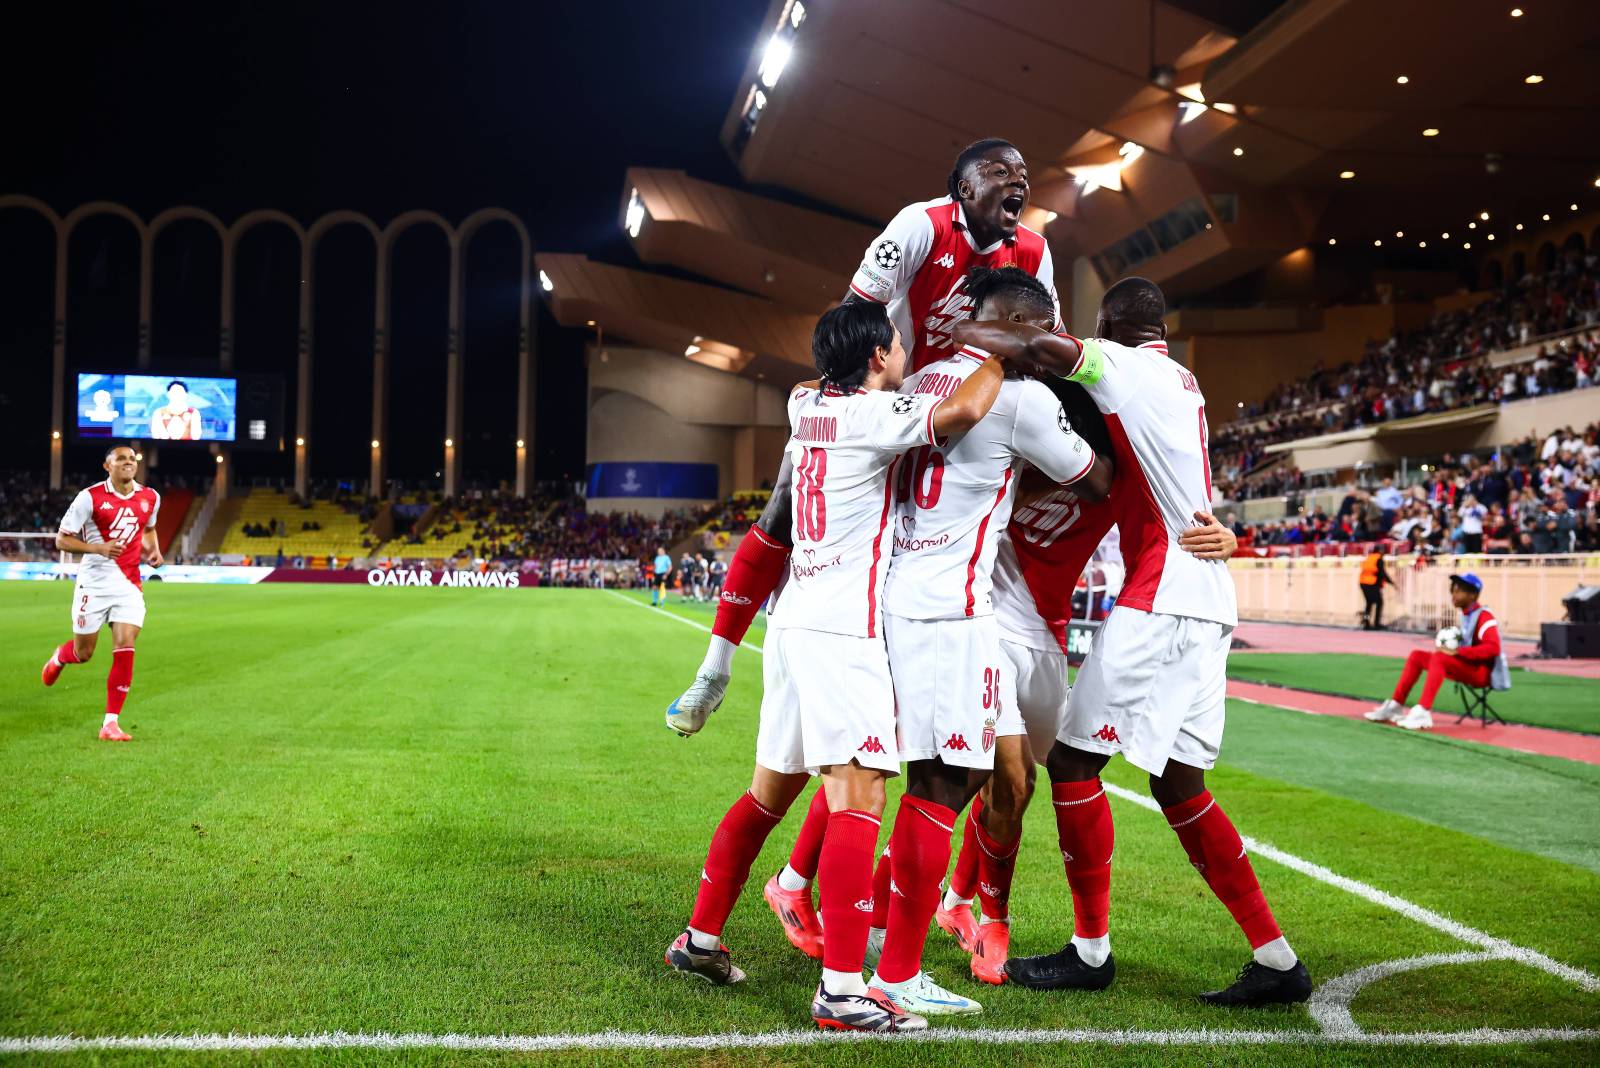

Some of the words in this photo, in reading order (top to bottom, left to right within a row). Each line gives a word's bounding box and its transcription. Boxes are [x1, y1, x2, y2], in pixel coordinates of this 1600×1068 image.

[797, 446, 827, 542] 18
[367, 569, 433, 587] QATAR
[439, 570, 520, 588] AIRWAYS
[80, 595, 89, 612] 2
[982, 667, 1000, 710] 36
